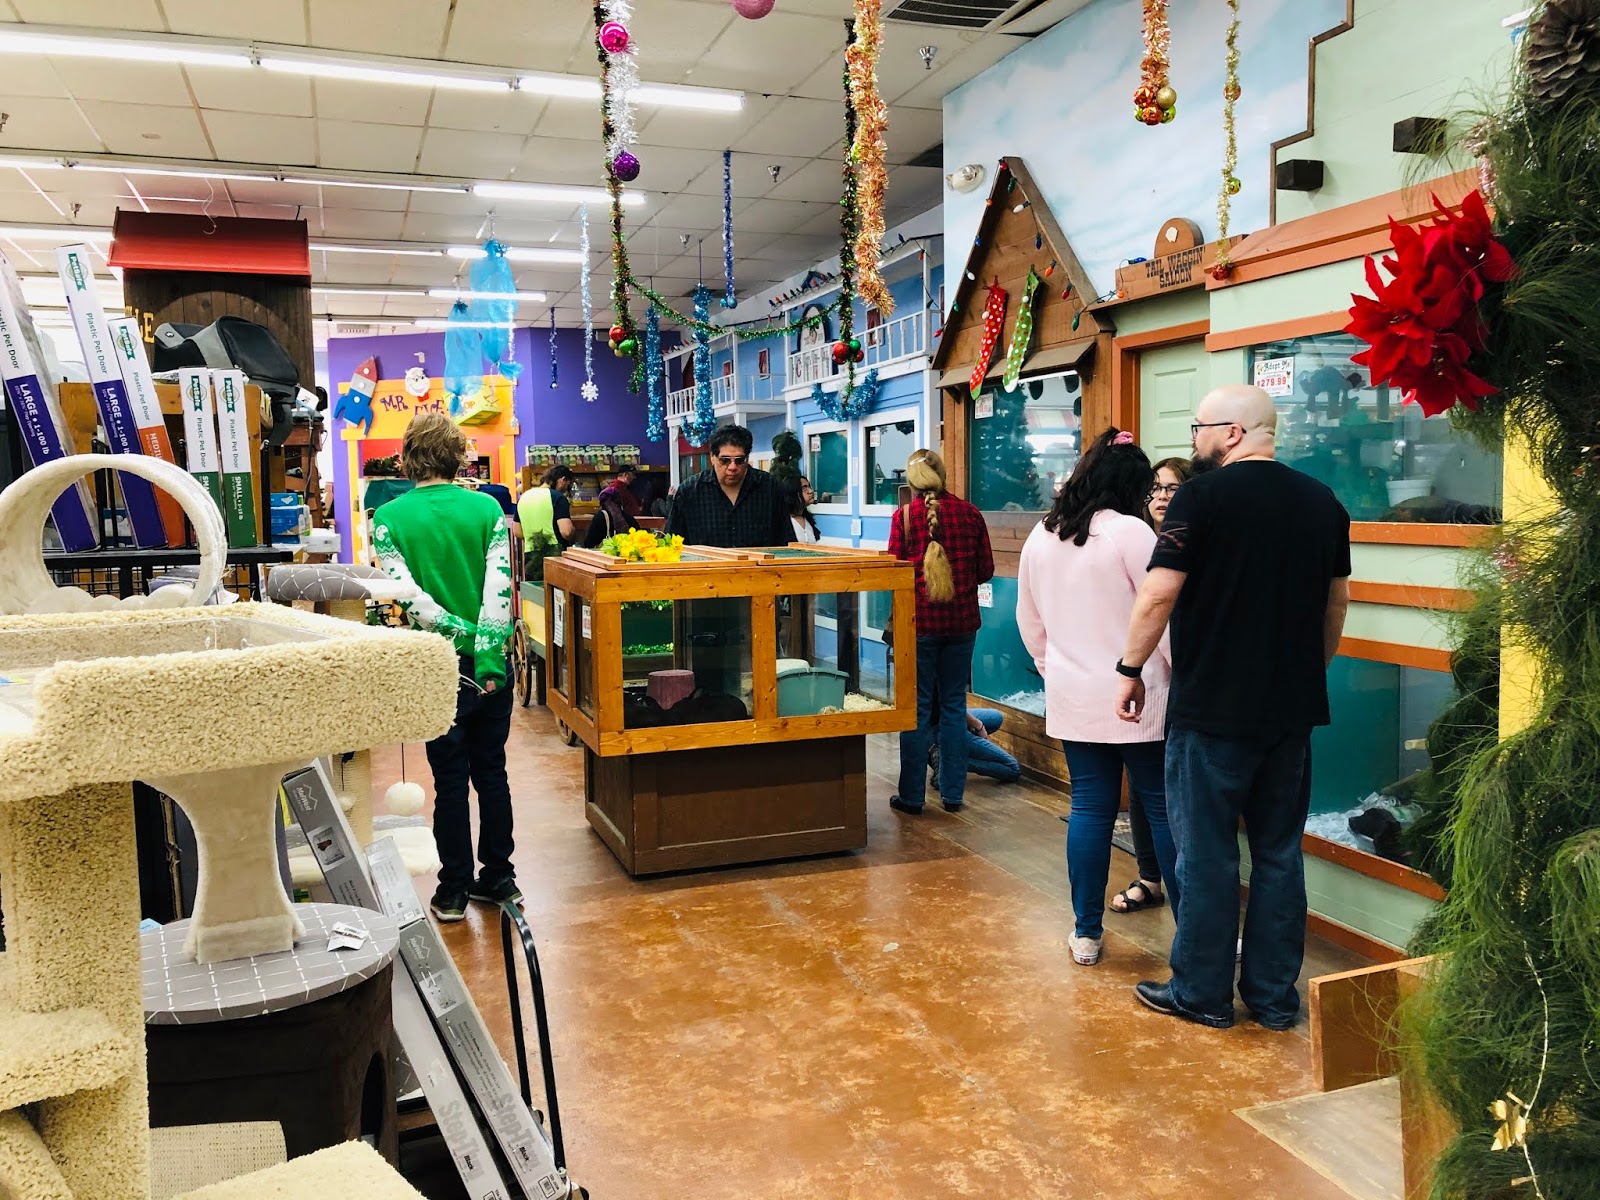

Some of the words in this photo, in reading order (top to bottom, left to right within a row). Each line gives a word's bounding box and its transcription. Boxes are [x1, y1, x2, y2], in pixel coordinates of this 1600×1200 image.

[70, 255, 83, 286] PetSafe
[1145, 258, 1164, 278] TAIL
[1159, 265, 1192, 289] SALOON
[85, 312, 98, 339] Plastic
[3, 333, 13, 348] Pet
[8, 349, 20, 370] Door
[93, 340, 103, 354] Pet
[97, 354, 108, 375] Door
[1263, 361, 1281, 373] Adopt
[133, 371, 143, 392] Plastic
[139, 393, 147, 405] Pet
[192, 378, 201, 408] PetSafe
[225, 380, 233, 409] PetSafe
[20, 383, 38, 416] LARGE
[33, 424, 47, 447] 1-100
[41, 446, 50, 455] lb
[106, 387, 122, 418] LARGE
[117, 425, 129, 447] 1-100
[142, 405, 150, 421] Door
[196, 417, 204, 439] Plastic
[149, 432, 163, 460] MEDIU
[202, 475, 210, 493] SMA
[234, 476, 243, 499] SMALL
[463, 1154, 475, 1171] Black
[519, 1146, 530, 1161] Black
